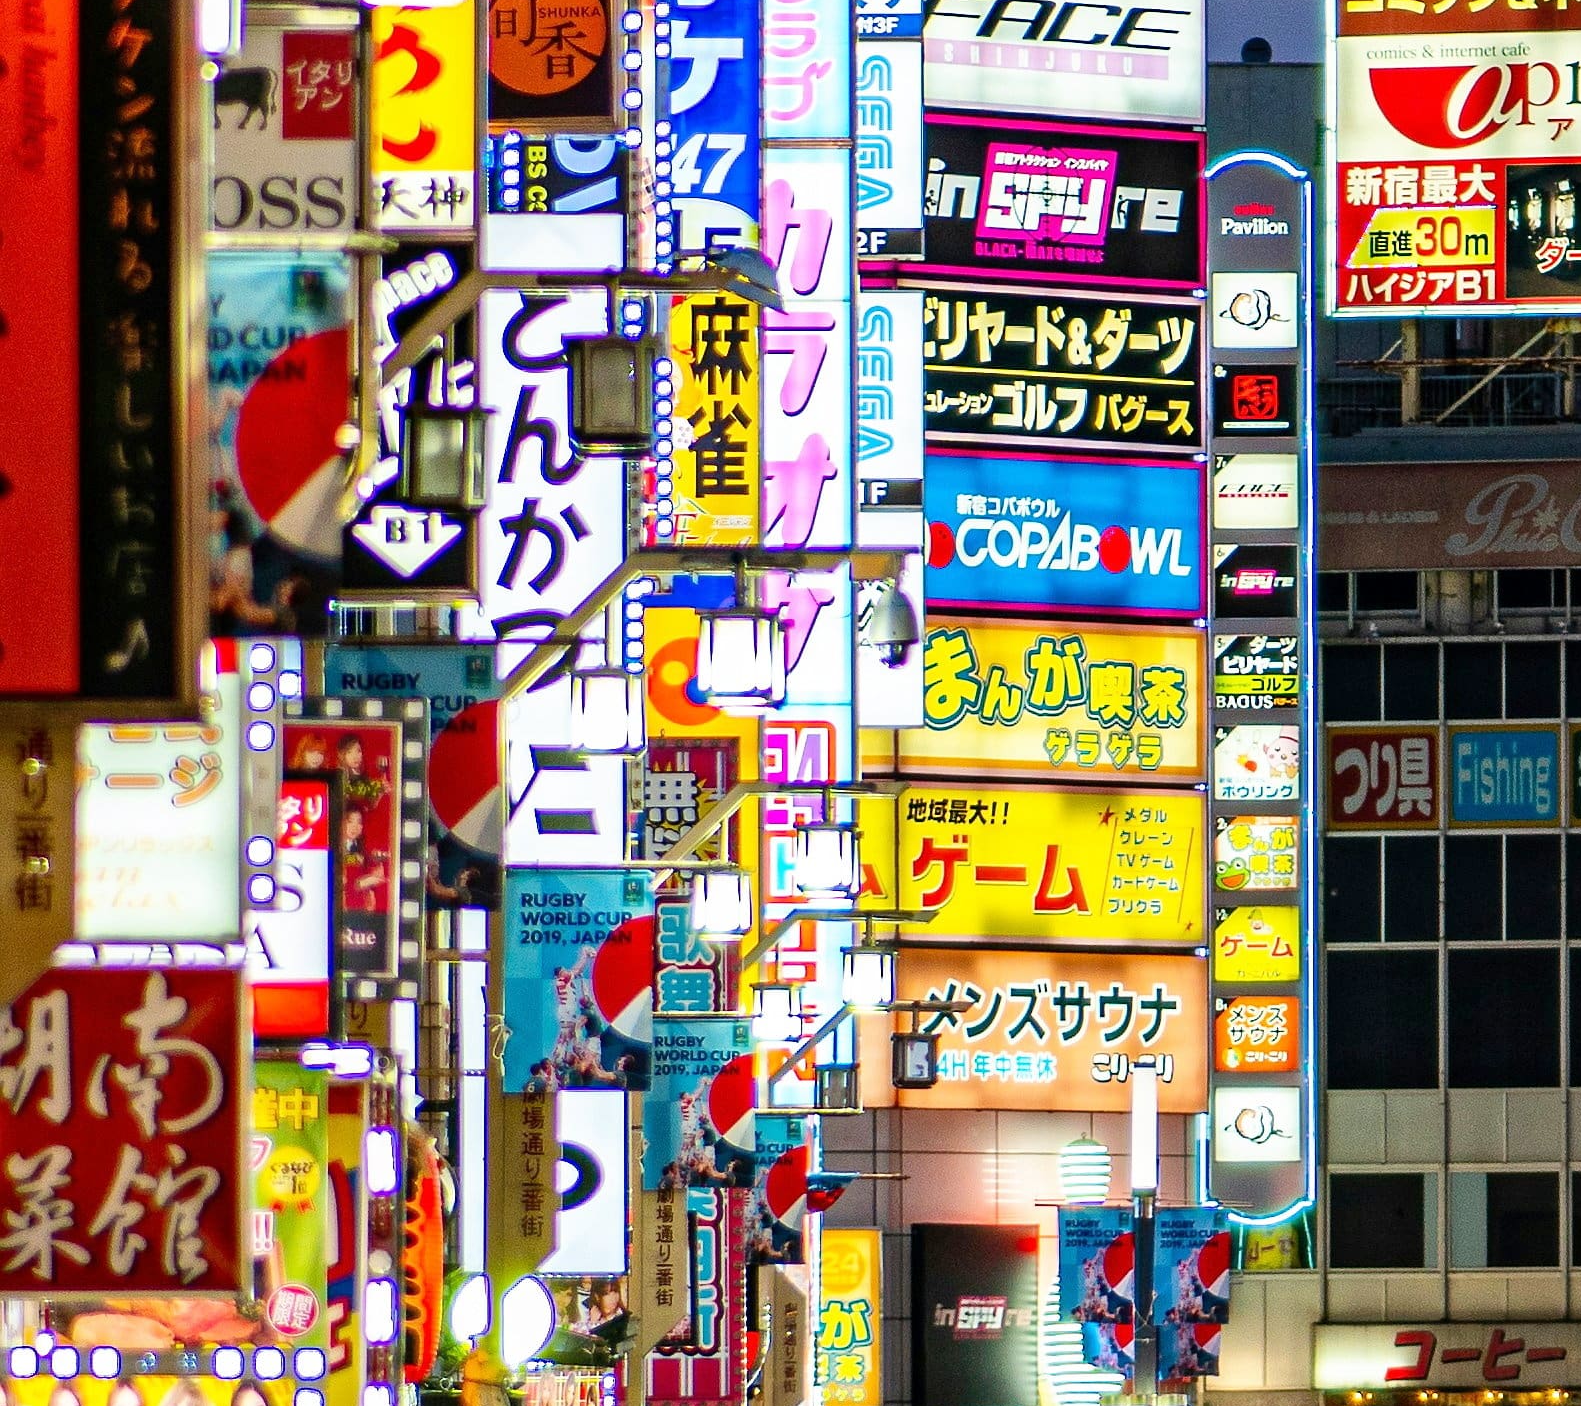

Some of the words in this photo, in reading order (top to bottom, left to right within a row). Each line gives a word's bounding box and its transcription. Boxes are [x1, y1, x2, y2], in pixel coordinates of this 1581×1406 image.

[538, 6, 601, 20] SHUNKA
[943, 45, 1135, 76] SHINJUKU
[1366, 44, 1417, 59] comics
[1422, 45, 1435, 58] &
[1440, 43, 1497, 58] internet
[1501, 41, 1531, 57] cafe
[857, 54, 893, 212] SEGA
[1346, 165, 1496, 205] 新宿最大
[1221, 218, 1289, 235] Pavilion
[1369, 215, 1489, 258] 直進30m
[1346, 268, 1496, 303] ハイジアB1
[858, 306, 894, 461] SEGA
[687, 297, 753, 499] 麻雀
[992, 378, 1088, 433] ゴルフ
[1095, 392, 1195, 436] バグース
[1249, 636, 1298, 653] ダーツ
[1223, 655, 1298, 675] ビリヤード
[341, 672, 420, 691] RUGBY
[924, 626, 1190, 730] まんが喫茶
[1250, 677, 1297, 692] ゴルフ
[1216, 695, 1273, 710] BAGUS
[1043, 728, 1165, 770] ゲラゲラ
[1334, 735, 1434, 818] つり具
[1457, 740, 1552, 814] Fishing
[1221, 785, 1293, 799] ボウリング
[905, 798, 1011, 825] 地域最大!!
[1122, 808, 1169, 824] メダル
[1119, 828, 1175, 847] クレーン
[1228, 824, 1295, 852] まんが
[1249, 853, 1295, 875] 喫茶
[912, 836, 1093, 916] ゲーム
[1111, 874, 1180, 893] カードゲーム
[521, 893, 587, 908] RUGBY
[521, 912, 592, 926] WORLD
[594, 912, 633, 926] CUP
[520, 930, 568, 946] 2019,
[570, 930, 633, 944] JAPAN
[1220, 935, 1294, 959] ゲーム
[920, 978, 1180, 1047] メンズサウナ
[1229, 1006, 1285, 1025] メンズ
[655, 1035, 705, 1049] RUGBY
[1228, 1026, 1286, 1044] サウナ
[655, 1050, 708, 1062] WORLD
[710, 1050, 741, 1062] CUP
[655, 1064, 690, 1077] 2019,
[693, 1064, 740, 1076] JAPAN
[973, 1054, 1058, 1082] 年中無休
[1384, 1329, 1566, 1382] コーヒー
